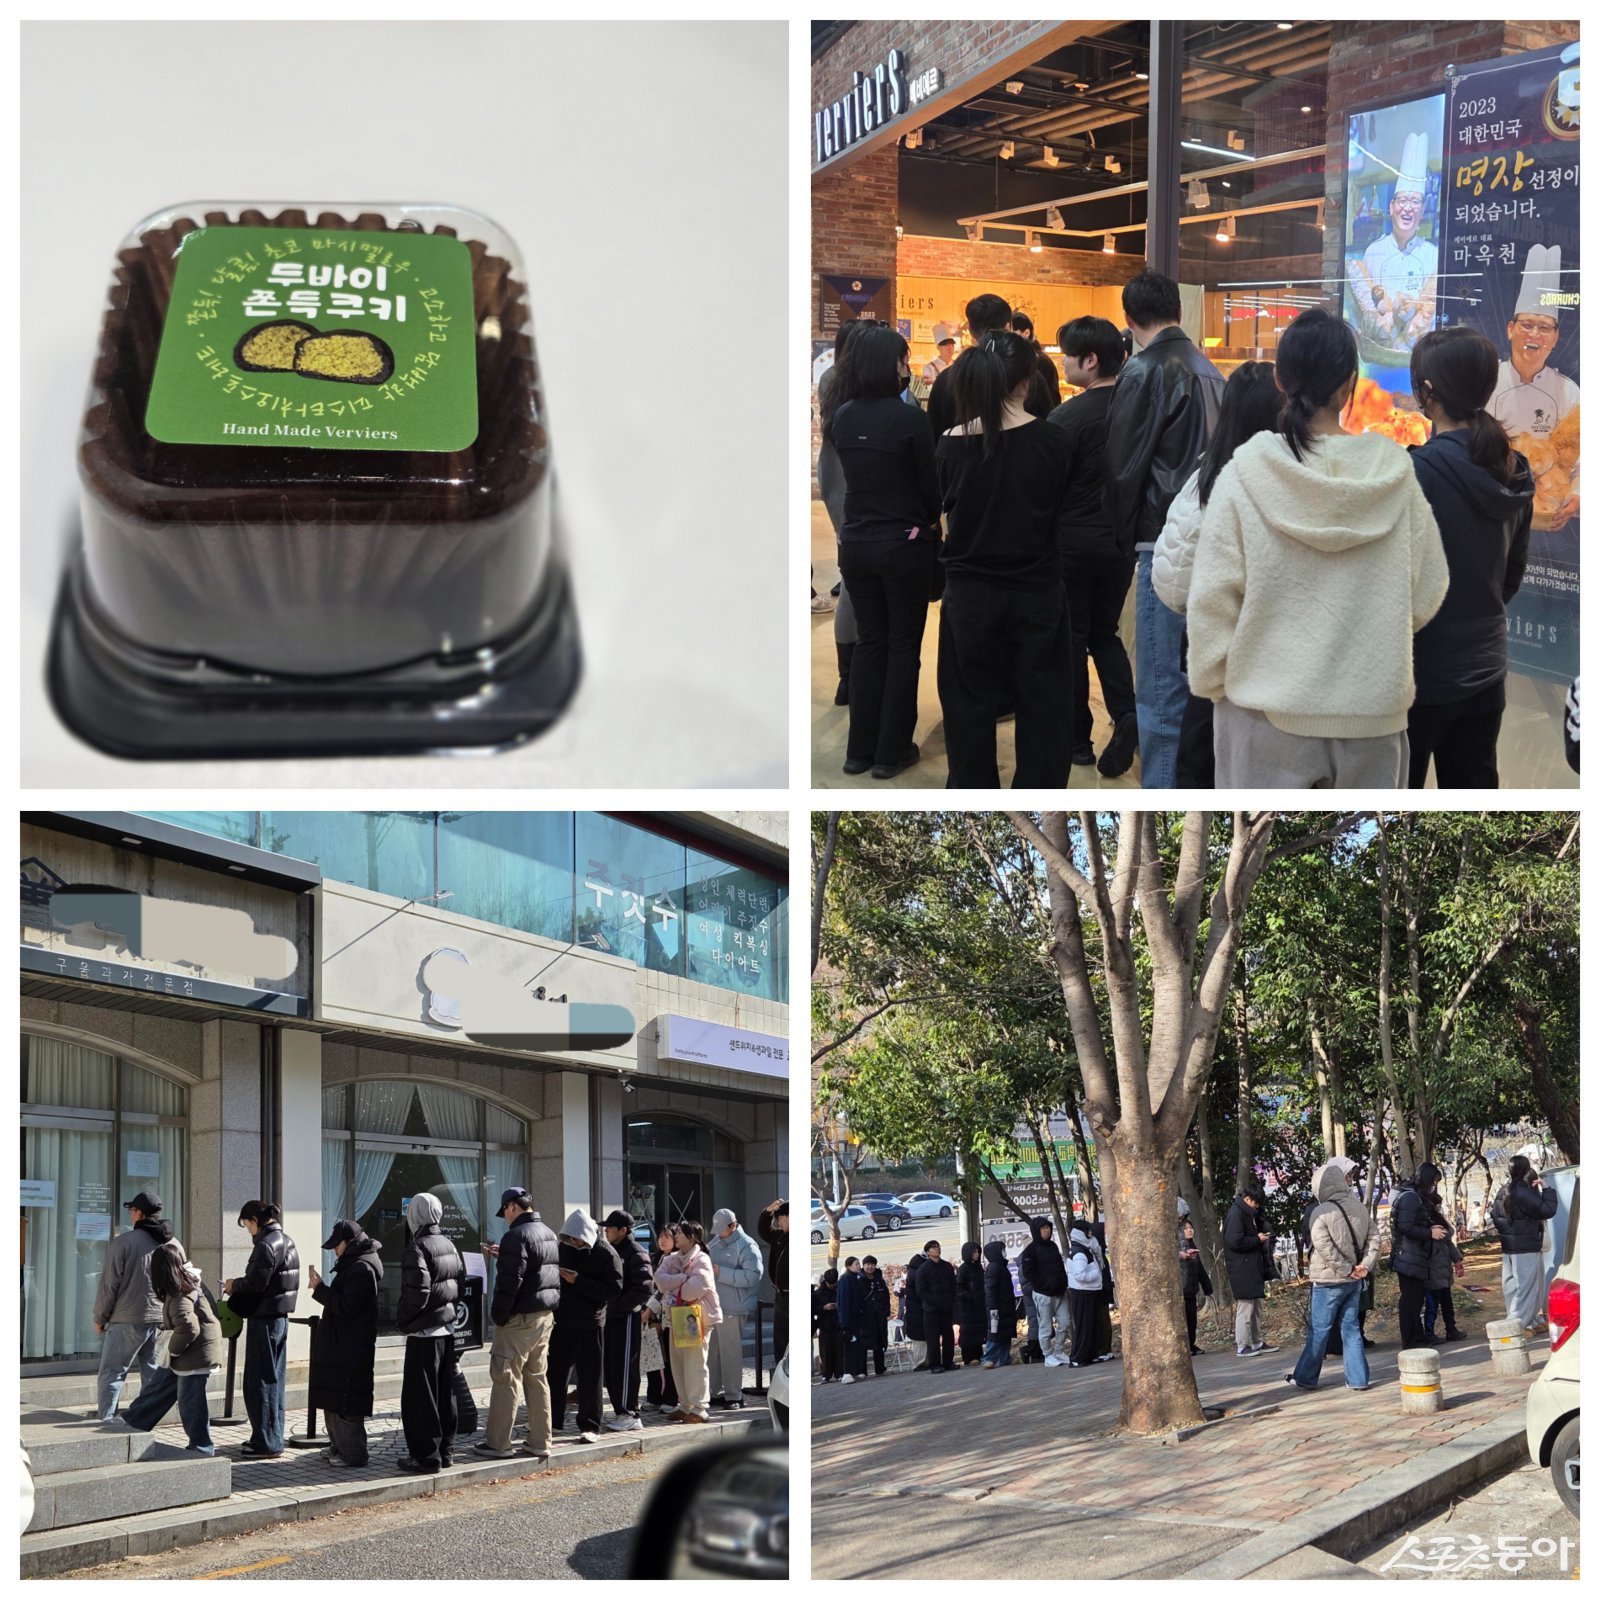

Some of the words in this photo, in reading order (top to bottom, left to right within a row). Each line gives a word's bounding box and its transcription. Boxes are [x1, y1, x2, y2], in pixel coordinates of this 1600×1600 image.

[815, 48, 901, 162] verviers
[1459, 96, 1497, 119] 2023
[1458, 118, 1523, 145] 대한민국
[1456, 150, 1535, 197] 명장
[1528, 165, 1580, 190] 선정이
[1454, 198, 1541, 224] 되었습니다.
[186, 289, 223, 326] 쫀득!
[263, 238, 303, 260] 초코
[311, 237, 411, 274] 마시멜로우
[266, 262, 388, 292] 두바이
[241, 288, 408, 323] 쫀득쿠키
[418, 287, 453, 343] 고소하고
[901, 294, 934, 310] iers
[195, 344, 374, 419] 피스타치오스프레드
[377, 350, 441, 402] 담백한
[222, 422, 270, 436] Hand
[273, 424, 321, 438] Made
[324, 425, 398, 441] Verviers
[1505, 615, 1557, 643] viers
[583, 858, 679, 932] 주짓수
[736, 910, 769, 934] 주짓수
[699, 920, 722, 943] 여성
[733, 931, 768, 957] 킥복싱
[711, 947, 760, 974] 다이어트
